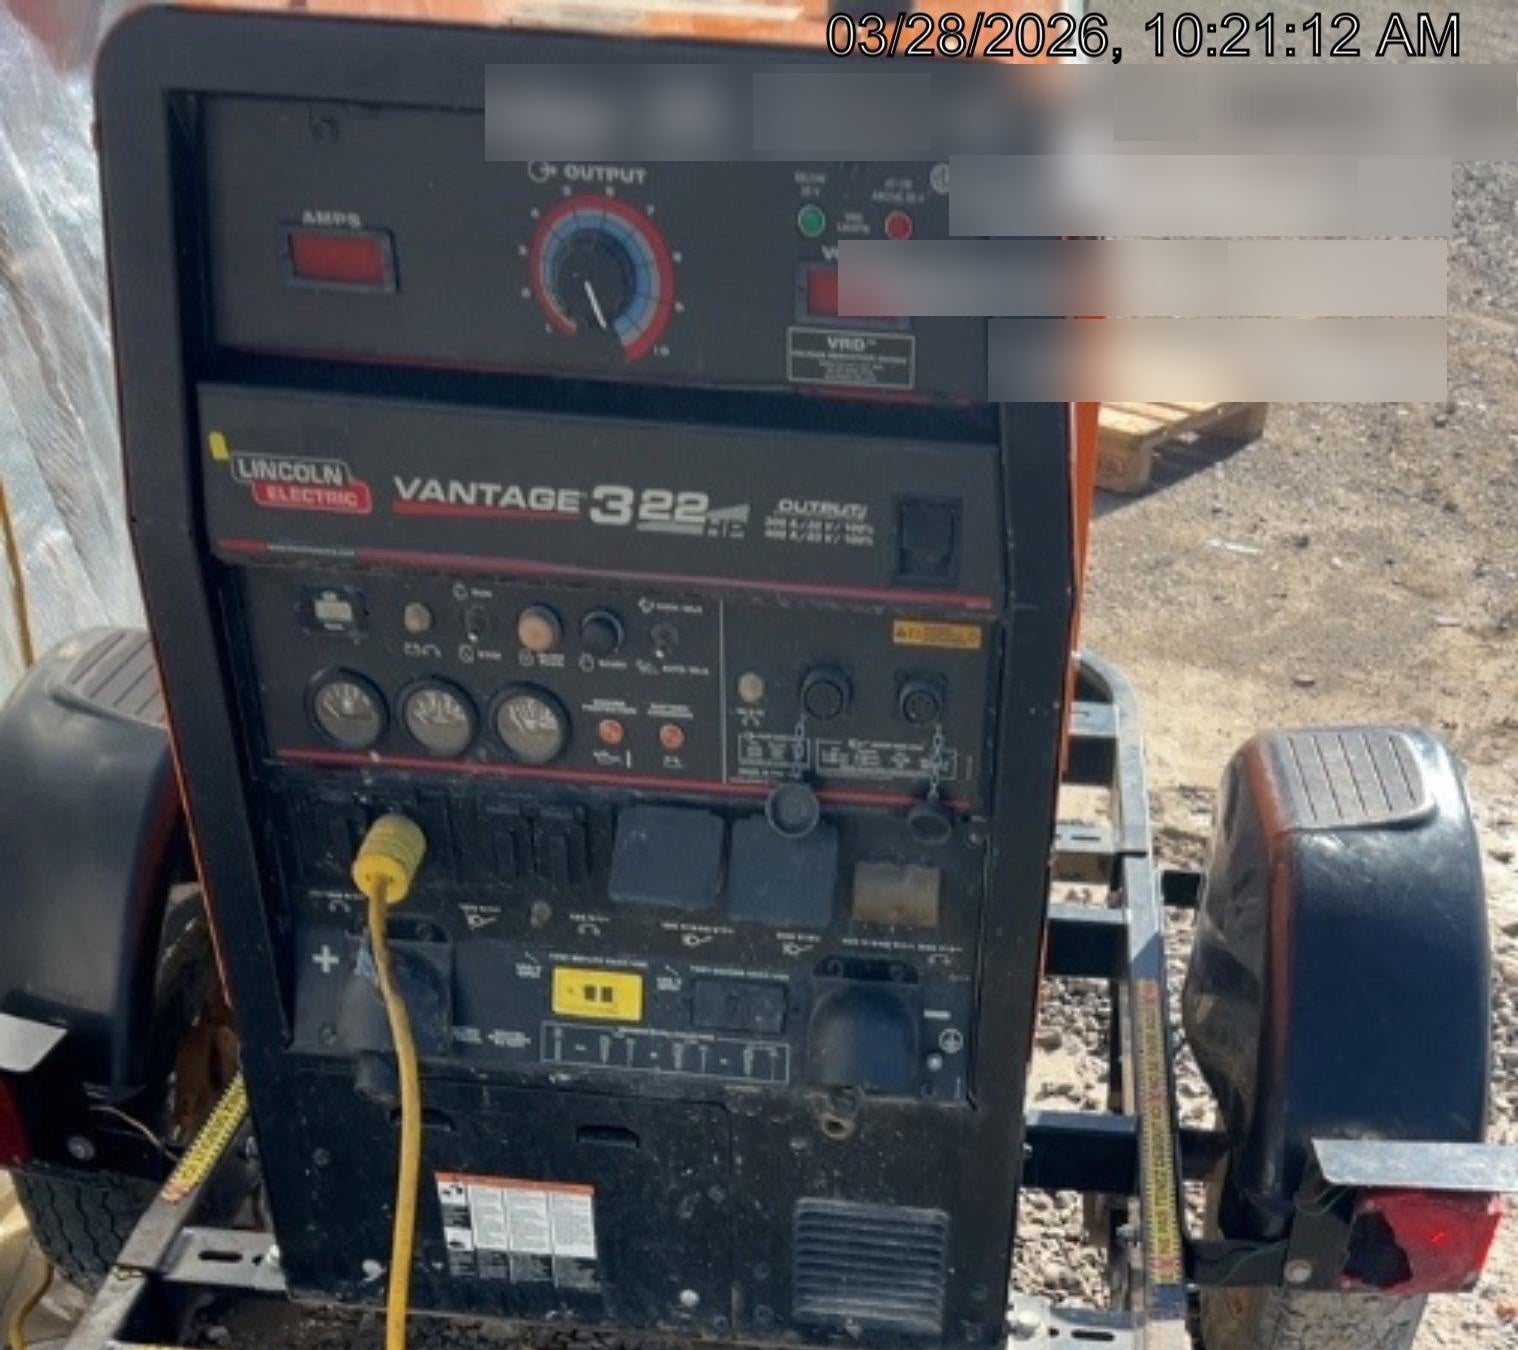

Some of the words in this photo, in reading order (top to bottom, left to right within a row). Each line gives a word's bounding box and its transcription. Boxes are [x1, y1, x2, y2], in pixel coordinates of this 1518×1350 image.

[563, 163, 647, 184] OUTPUT
[302, 209, 361, 228] AMPS
[237, 457, 344, 486] LINCOLN
[266, 483, 358, 509] ELECTRIC
[394, 475, 580, 514] VANTAGE
[589, 484, 709, 526] 322
